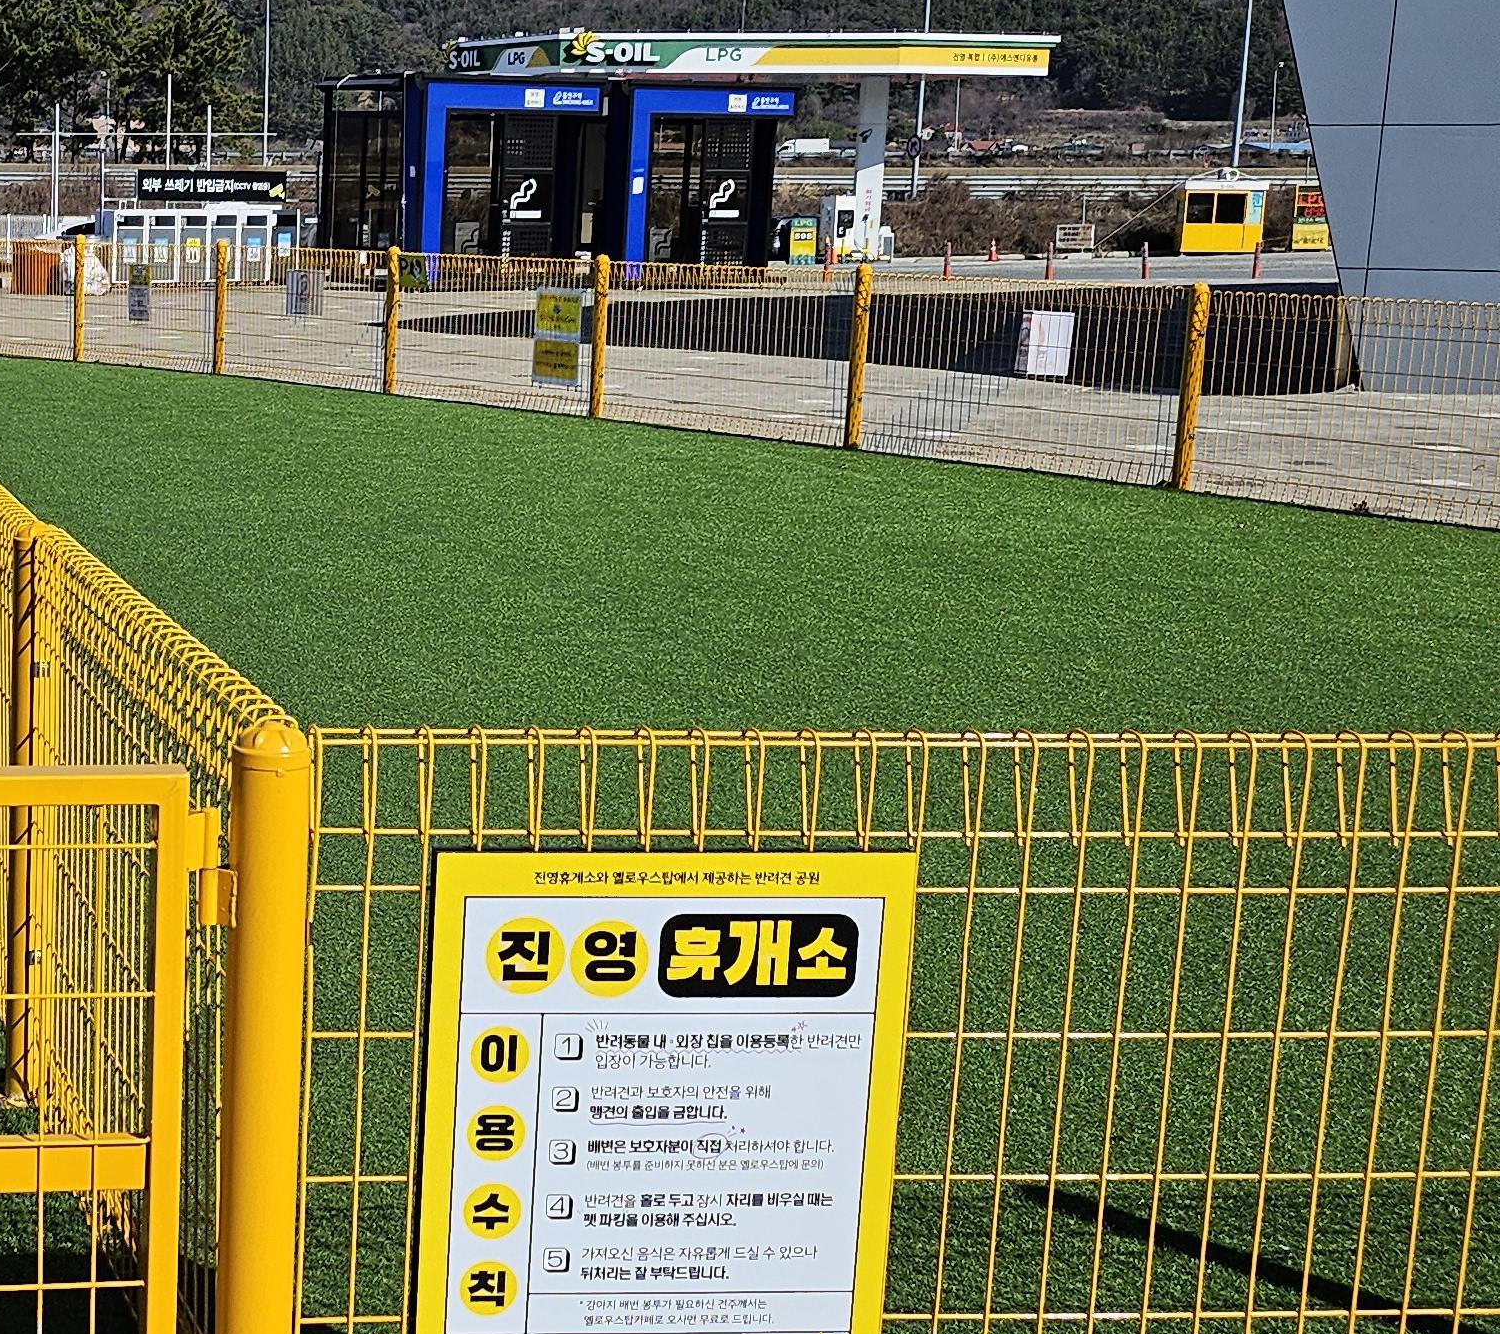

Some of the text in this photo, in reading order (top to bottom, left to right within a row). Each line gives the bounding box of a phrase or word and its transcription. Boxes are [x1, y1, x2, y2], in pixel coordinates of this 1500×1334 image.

[448, 49, 481, 70] S-OIL
[507, 51, 525, 65] LPG
[585, 42, 660, 63] S-OIL
[705, 47, 742, 61] LPG
[142, 177, 162, 192] 외부
[164, 178, 193, 192] 쓰레기
[534, 871, 820, 885] 진영휴게소와 옐로우스탑에서 제공하는 반려견 공원
[667, 920, 848, 986] 휴개소
[596, 1034, 650, 1049] 반려동물
[653, 1034, 667, 1049] 내
[675, 1033, 703, 1049] 외장
[807, 1034, 861, 1050] 반려견만
[595, 1054, 712, 1069] 입장이 가능합니다.
[591, 1085, 771, 1100] 반려견과 보호자의 안전을 위해
[590, 1105, 728, 1119] 맹견의 출입을 금합니다.
[588, 1139, 835, 1153] 배변은 보호자분이 직접 처리하셔야 합니다.
[584, 1193, 833, 1208] 반려견을 홀로 두고 잠시 자리를 비우실 때는
[583, 1213, 737, 1227] 펫 파킹을 이용해 주십시오.
[581, 1245, 818, 1261] 가져오신 음식은 자유롭게 드실 수 있으나
[580, 1266, 729, 1280] 뒤처리는 잘 부탁드립니다.
